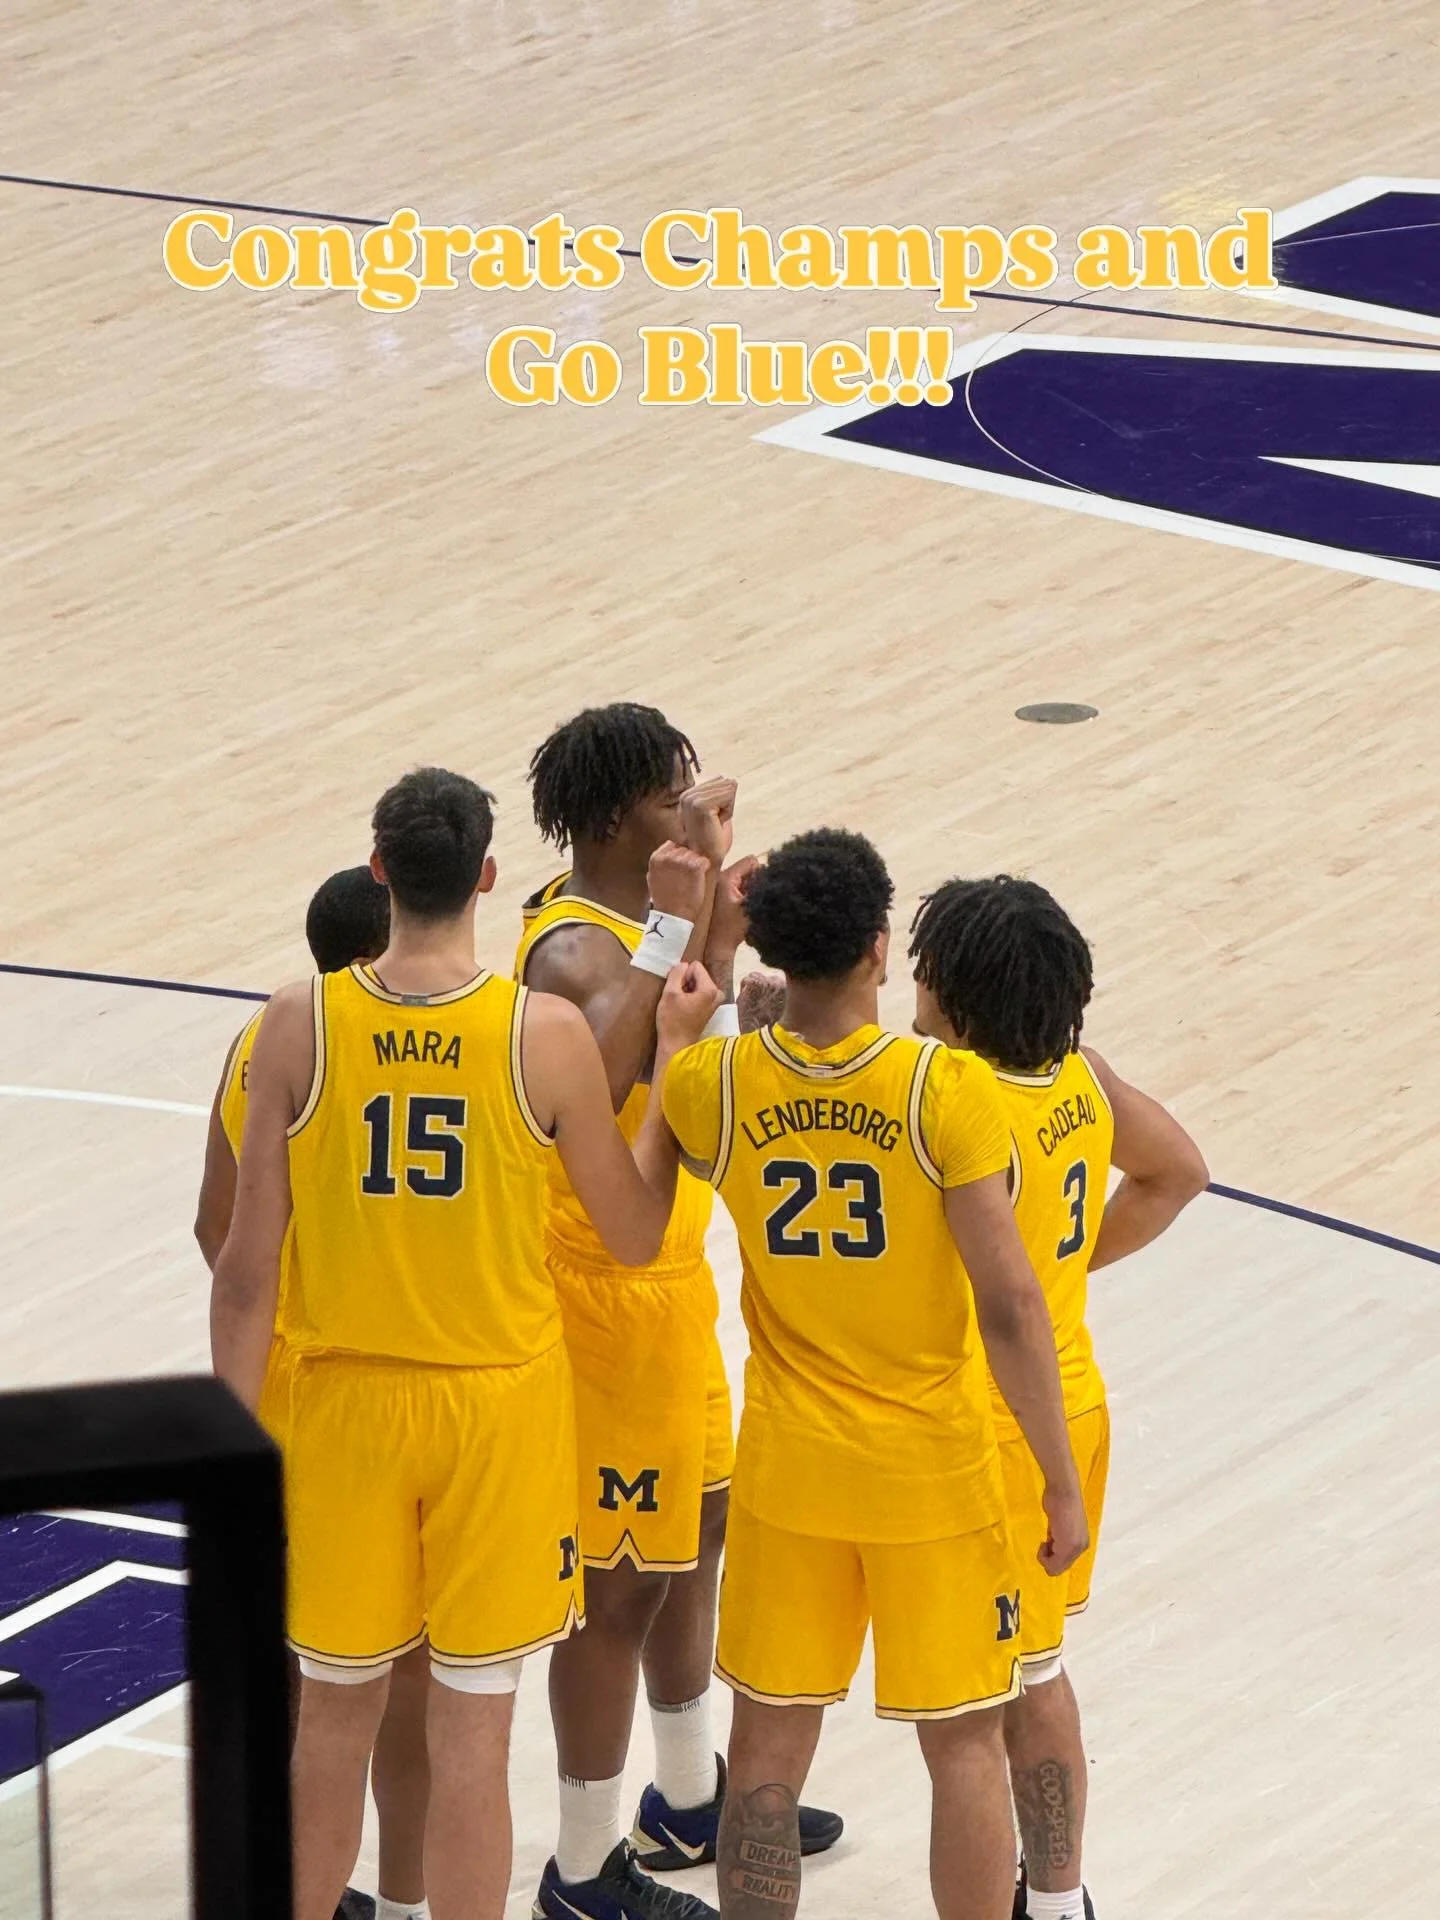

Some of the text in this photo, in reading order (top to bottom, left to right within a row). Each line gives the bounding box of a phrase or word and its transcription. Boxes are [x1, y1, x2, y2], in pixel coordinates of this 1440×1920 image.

[372, 1030, 462, 1070] MARA
[361, 1092, 468, 1199] 15
[741, 1098, 903, 1153] LENDEBORG
[1036, 1094, 1097, 1157] CADEAU
[761, 1157, 888, 1259] 23
[1055, 1158, 1088, 1261] 3
[597, 1466, 660, 1512] M
